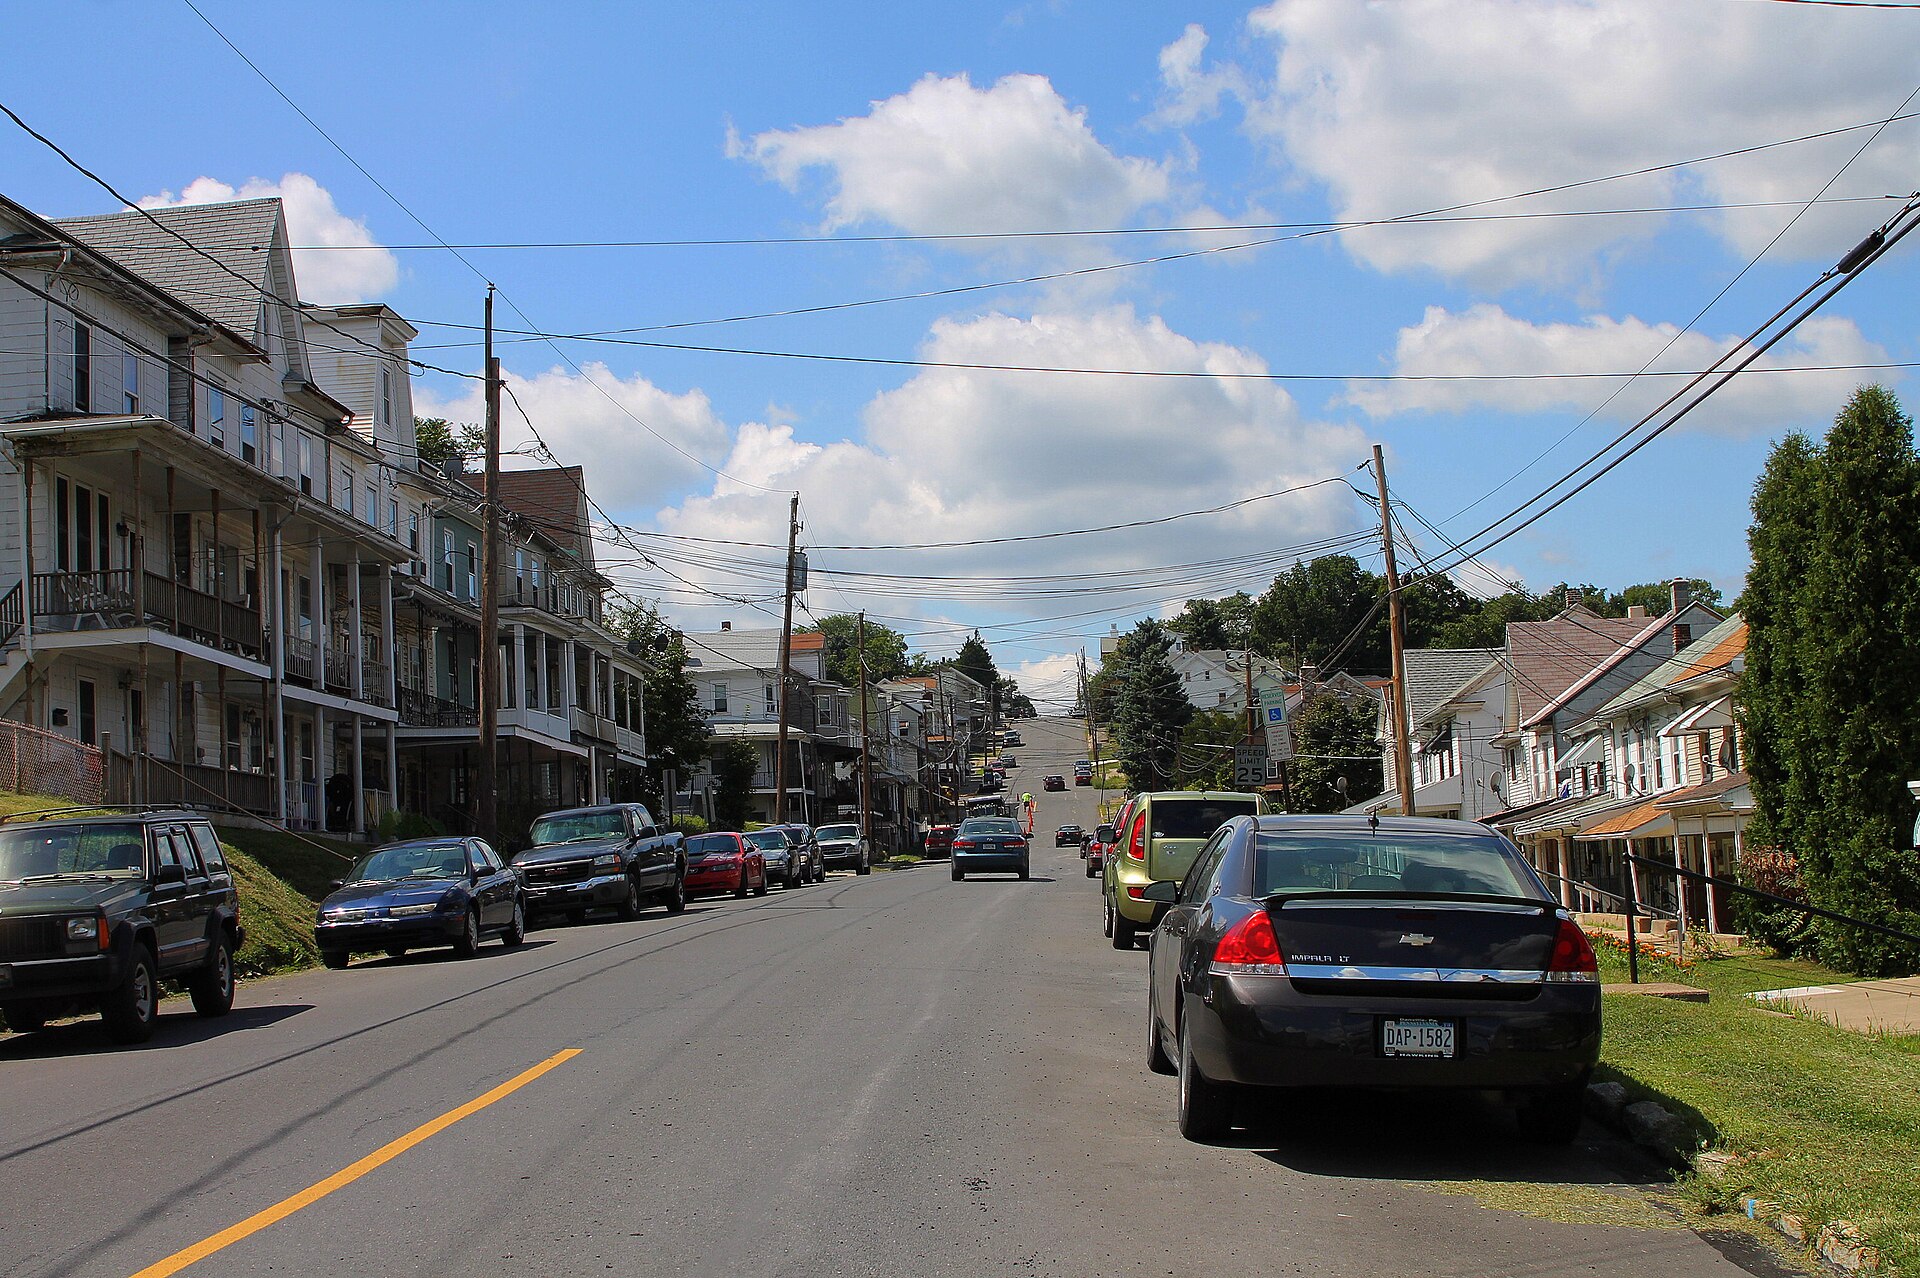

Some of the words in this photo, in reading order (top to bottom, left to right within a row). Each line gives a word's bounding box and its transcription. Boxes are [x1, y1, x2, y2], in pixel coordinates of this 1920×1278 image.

[1240, 757, 1261, 765] LIMIT
[1237, 767, 1263, 782] 25
[1291, 954, 1332, 962] IMPALA
[1339, 955, 1350, 963] LT
